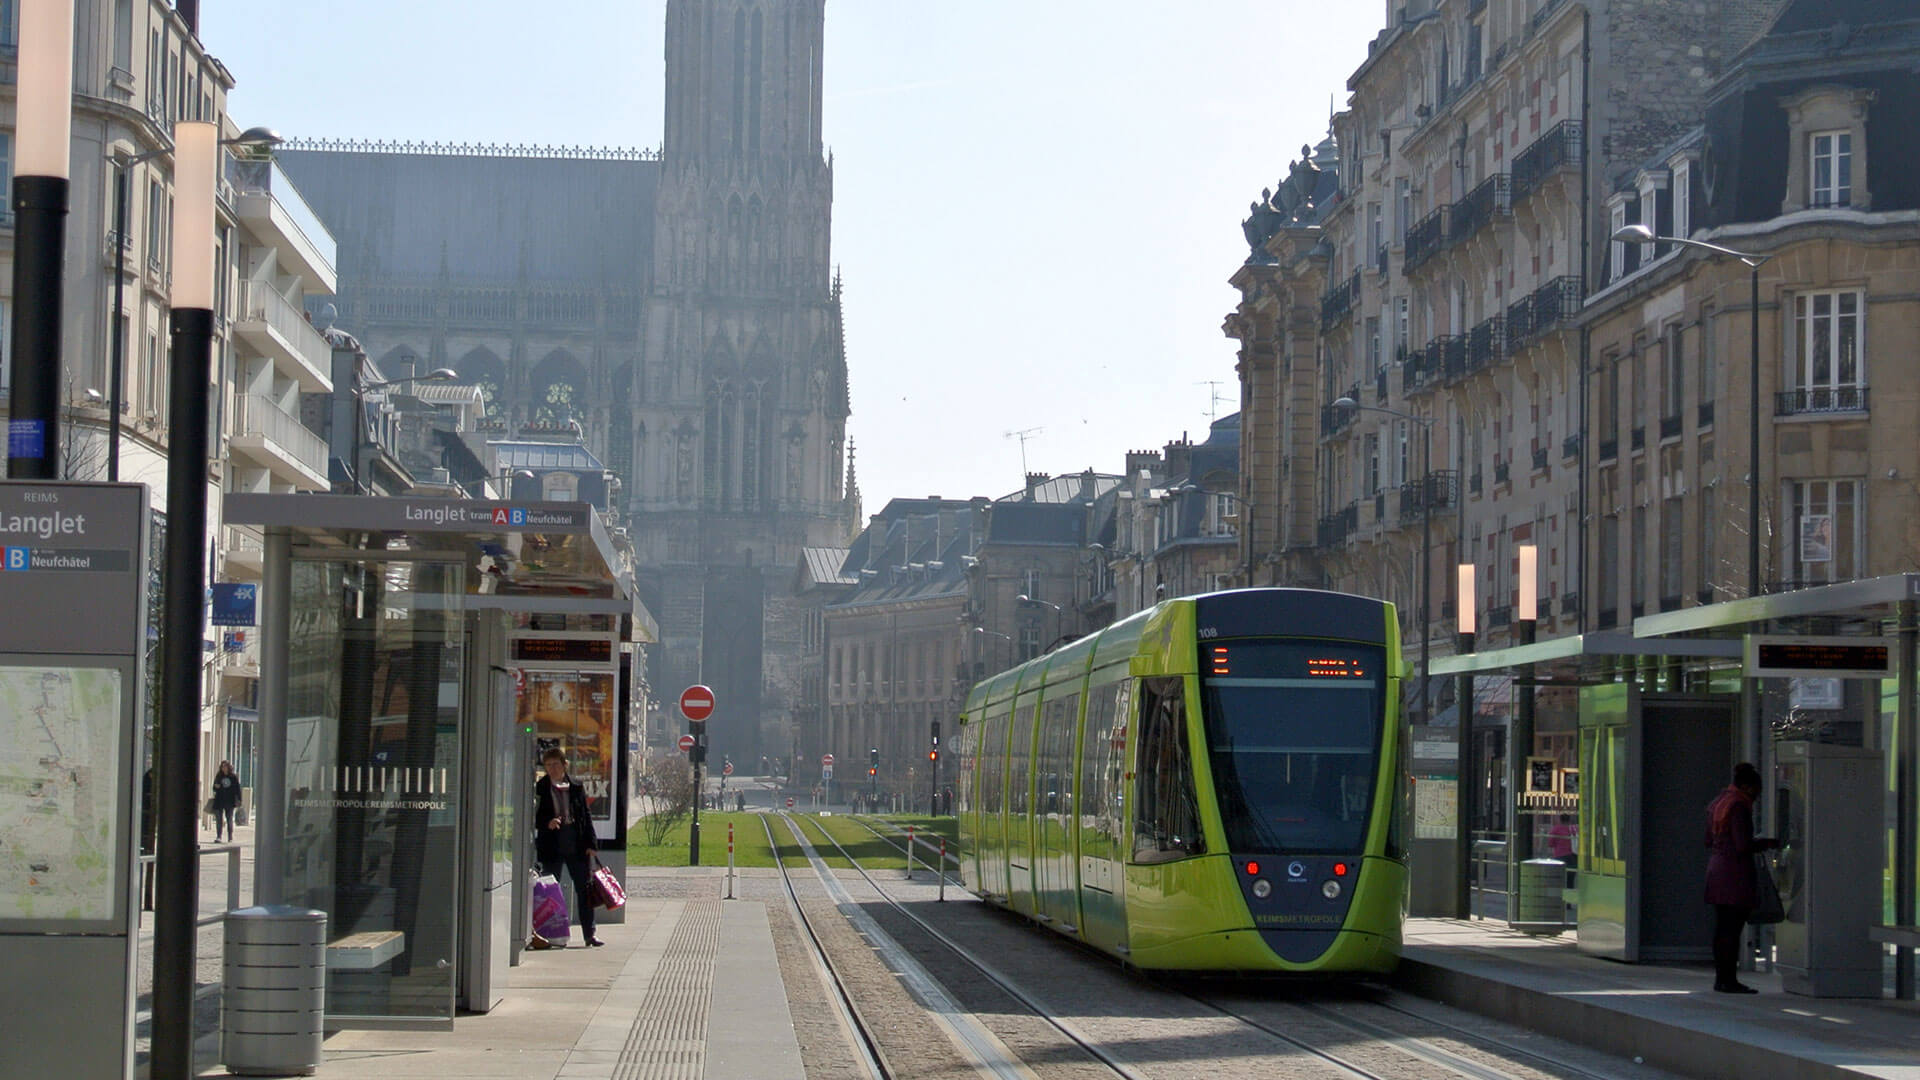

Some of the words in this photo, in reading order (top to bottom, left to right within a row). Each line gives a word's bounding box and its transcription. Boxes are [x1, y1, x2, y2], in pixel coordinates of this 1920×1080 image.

[24, 492, 58, 503] REIMS
[406, 505, 466, 525] Langlet
[470, 511, 492, 520] tram
[494, 511, 507, 523] A
[512, 511, 522, 523] B
[527, 513, 572, 525] Neufchâtel
[0, 511, 86, 539] Langlet
[10, 549, 24, 568] B
[31, 556, 90, 568] Neufchâtel
[1199, 627, 1218, 639] 108
[1256, 914, 1341, 924] REIMSMETROPOLE
